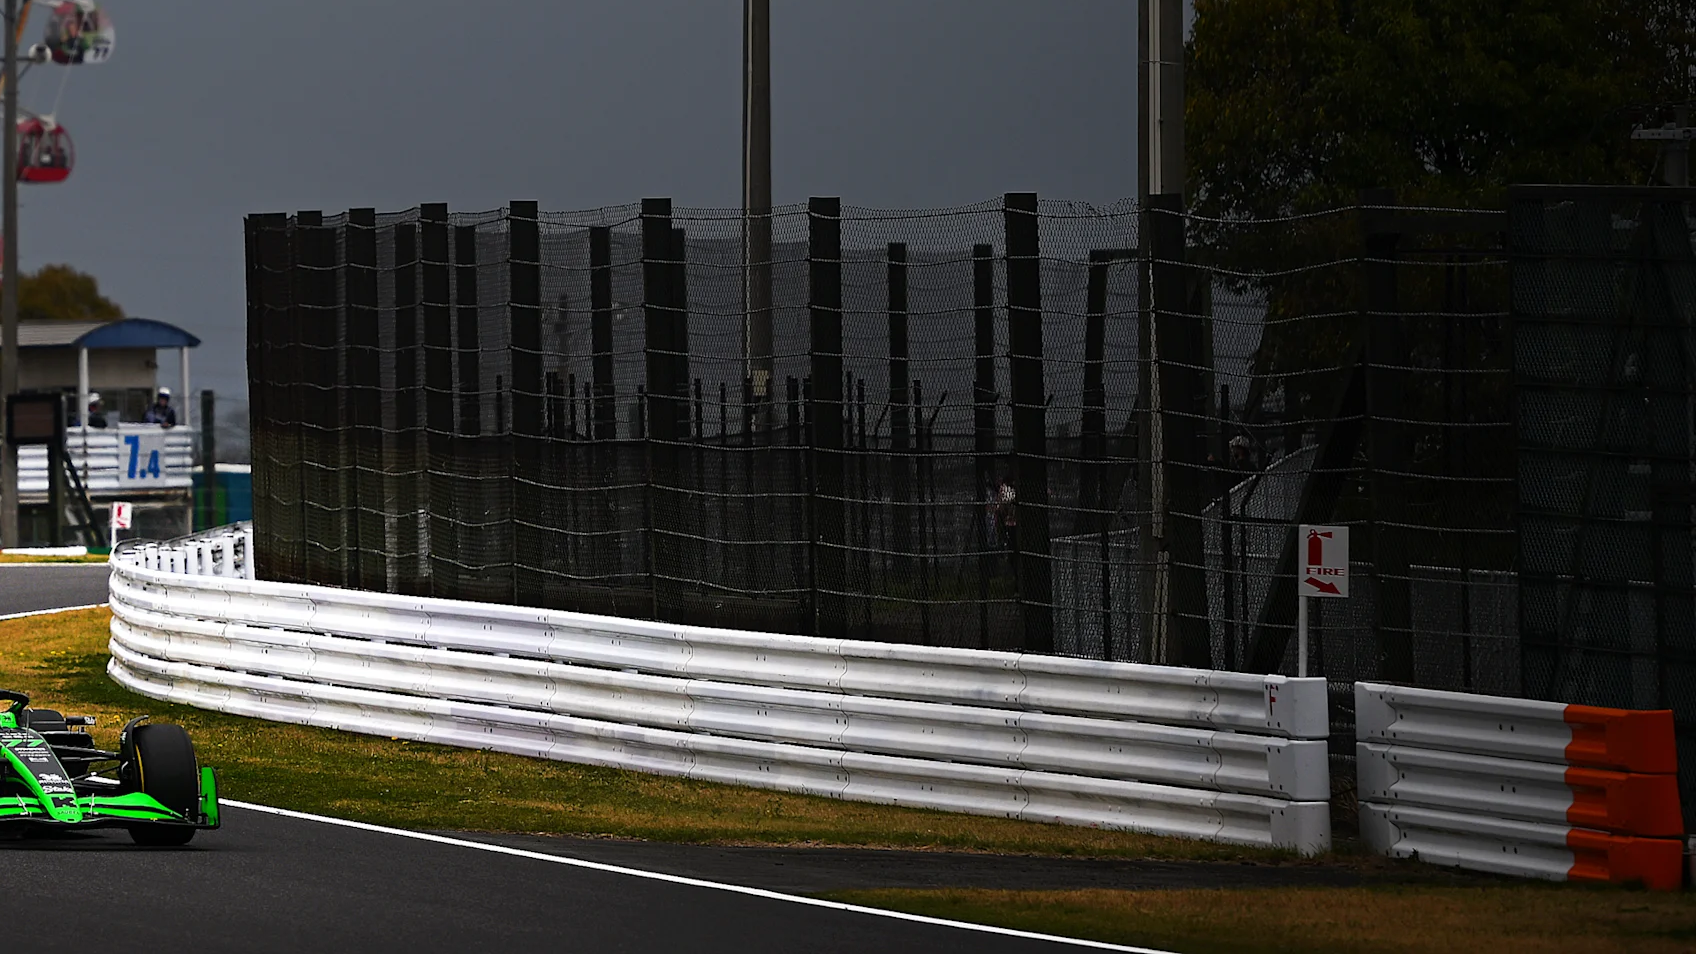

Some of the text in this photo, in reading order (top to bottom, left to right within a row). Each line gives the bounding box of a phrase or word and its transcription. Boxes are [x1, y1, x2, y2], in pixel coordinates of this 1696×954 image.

[124, 435, 160, 479] 7.4
[1305, 567, 1345, 577] FIRE
[1, 739, 44, 748] 77
[42, 785, 75, 795] Stake
